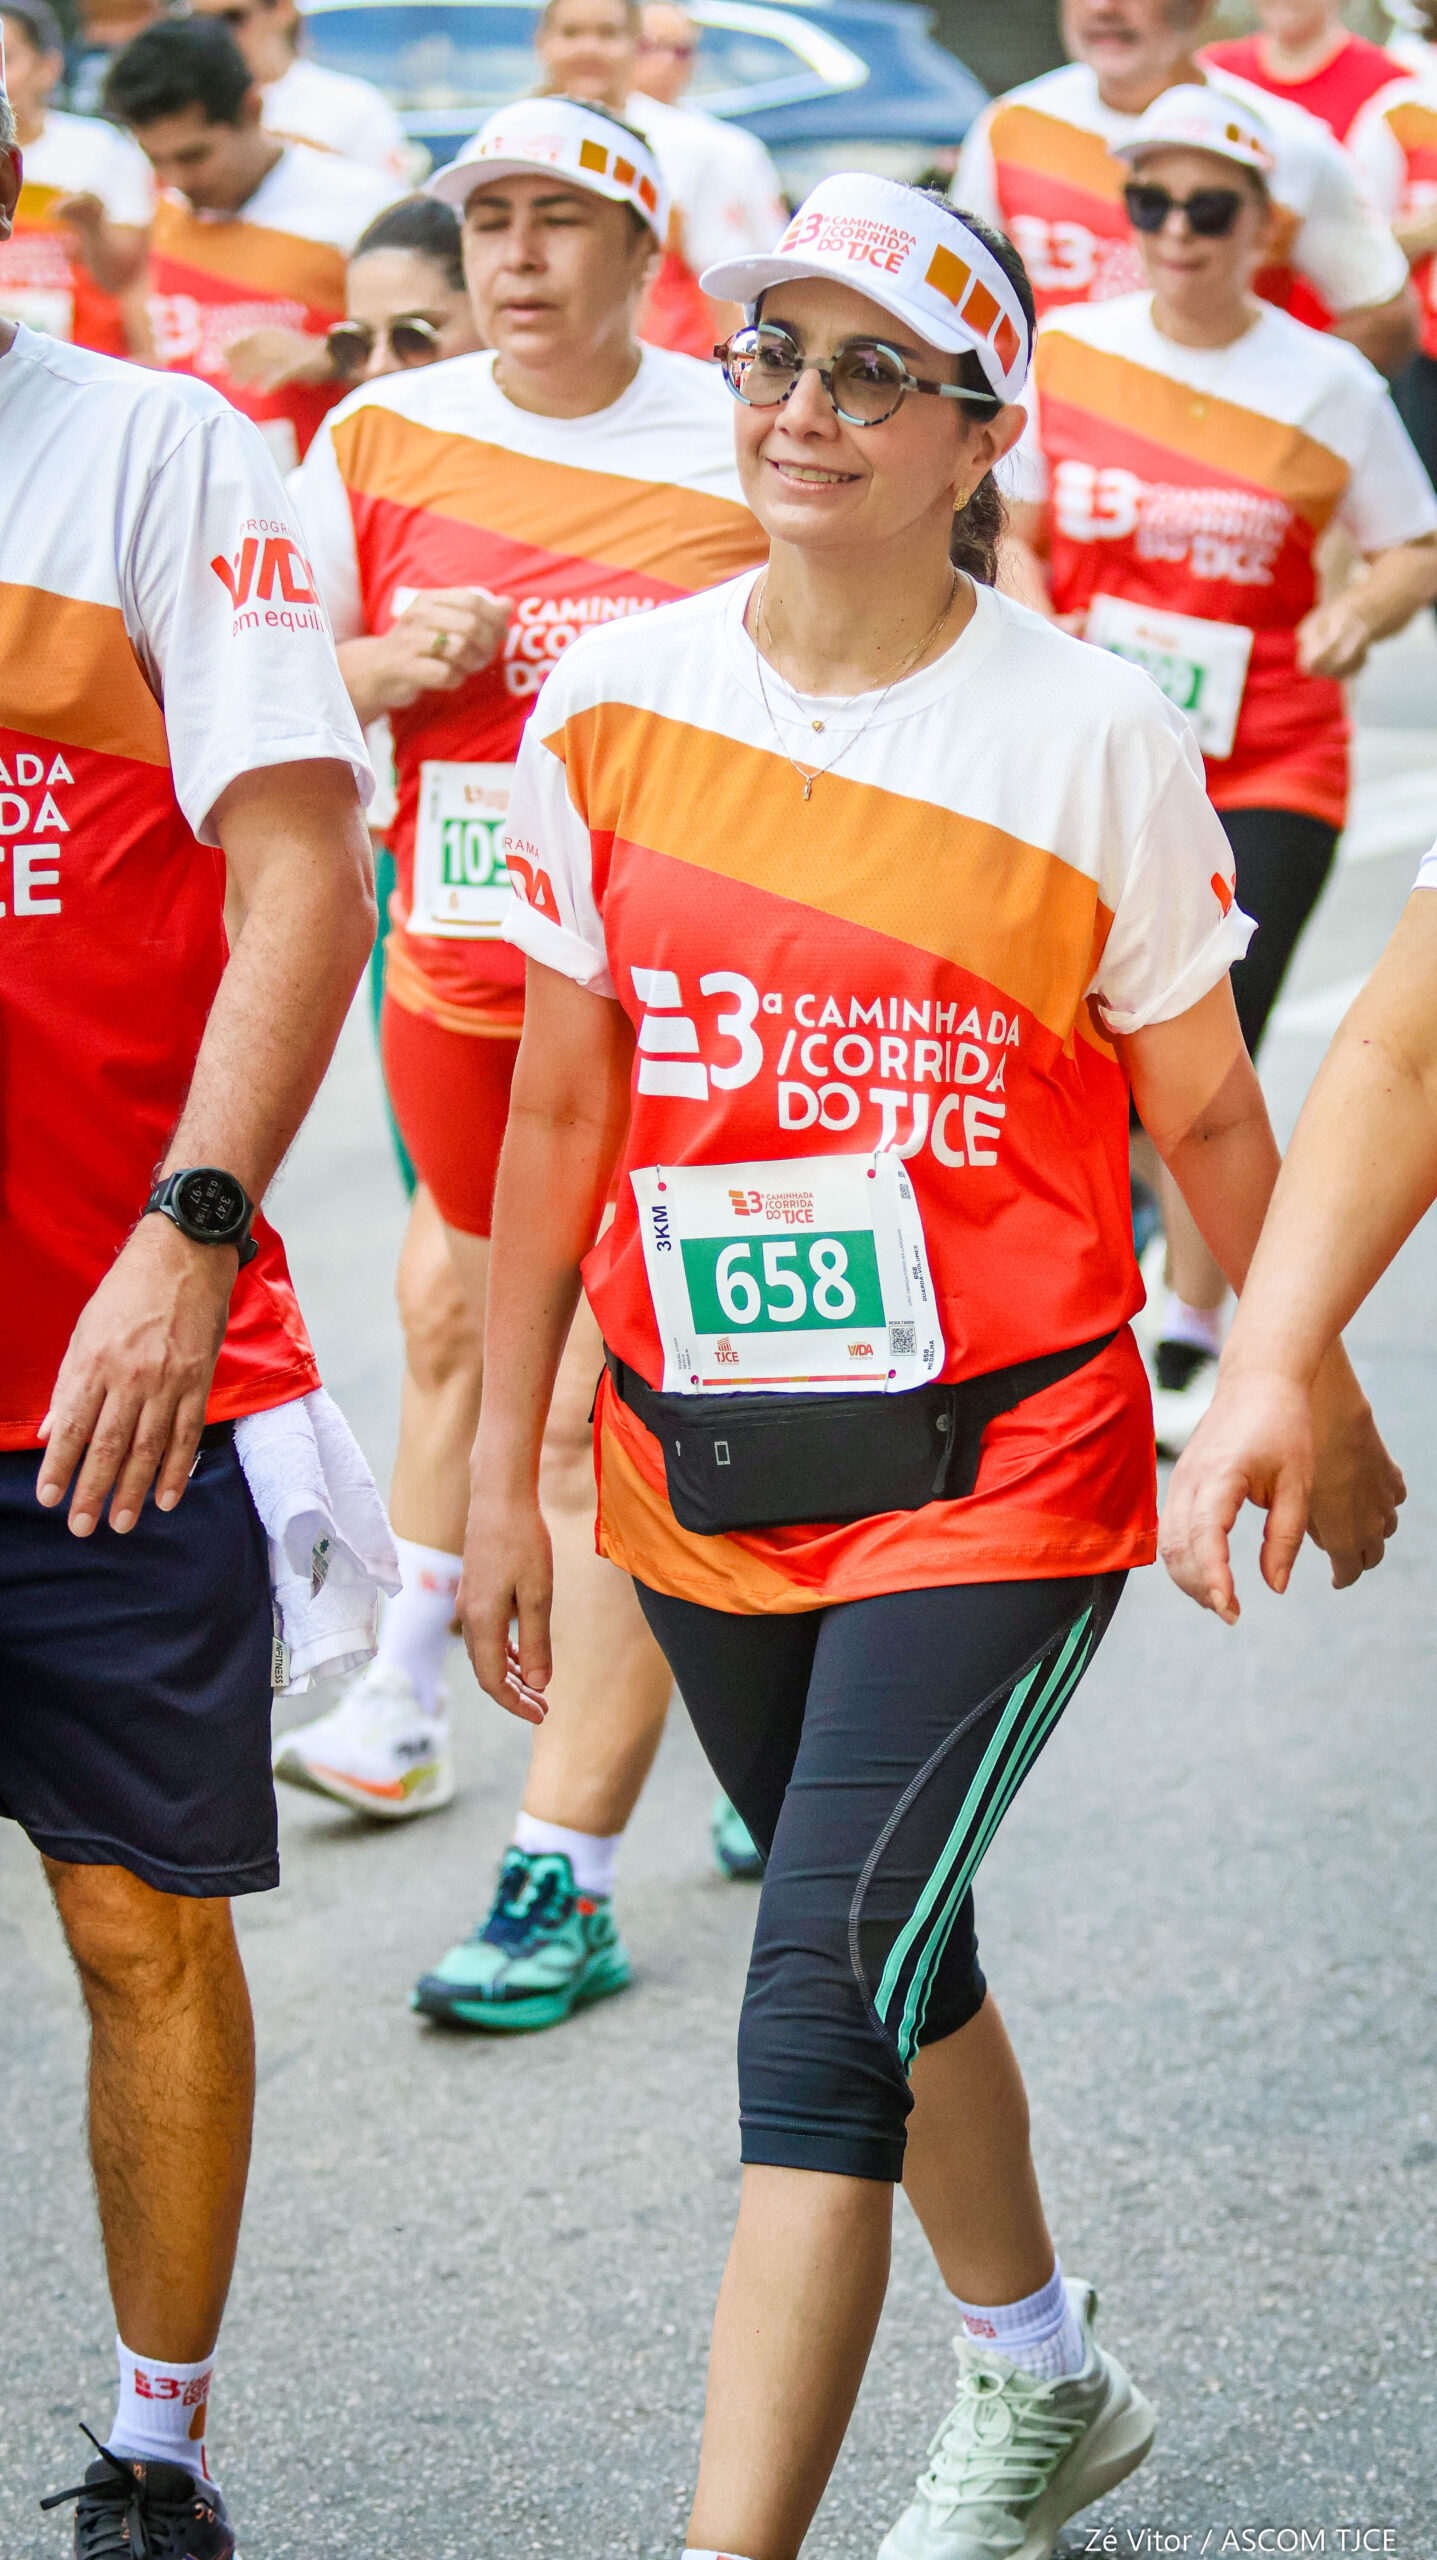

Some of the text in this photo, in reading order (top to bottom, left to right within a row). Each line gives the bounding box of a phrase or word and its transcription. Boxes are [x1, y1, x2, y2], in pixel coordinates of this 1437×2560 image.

[832, 216, 917, 246] CAMINHADA
[817, 239, 905, 275] DO TJCE
[210, 536, 321, 611] VID
[517, 596, 672, 626] CAMINH
[794, 993, 1020, 1047] CAMINHADA
[778, 1081, 1006, 1168] DO TJCE
[766, 1192, 814, 1201] CAMINHADA
[652, 1205, 672, 1252] 3KM
[766, 1209, 814, 1224] DO TJCE
[715, 1238, 857, 1325] 658
[714, 1352, 739, 1363] TJCE
